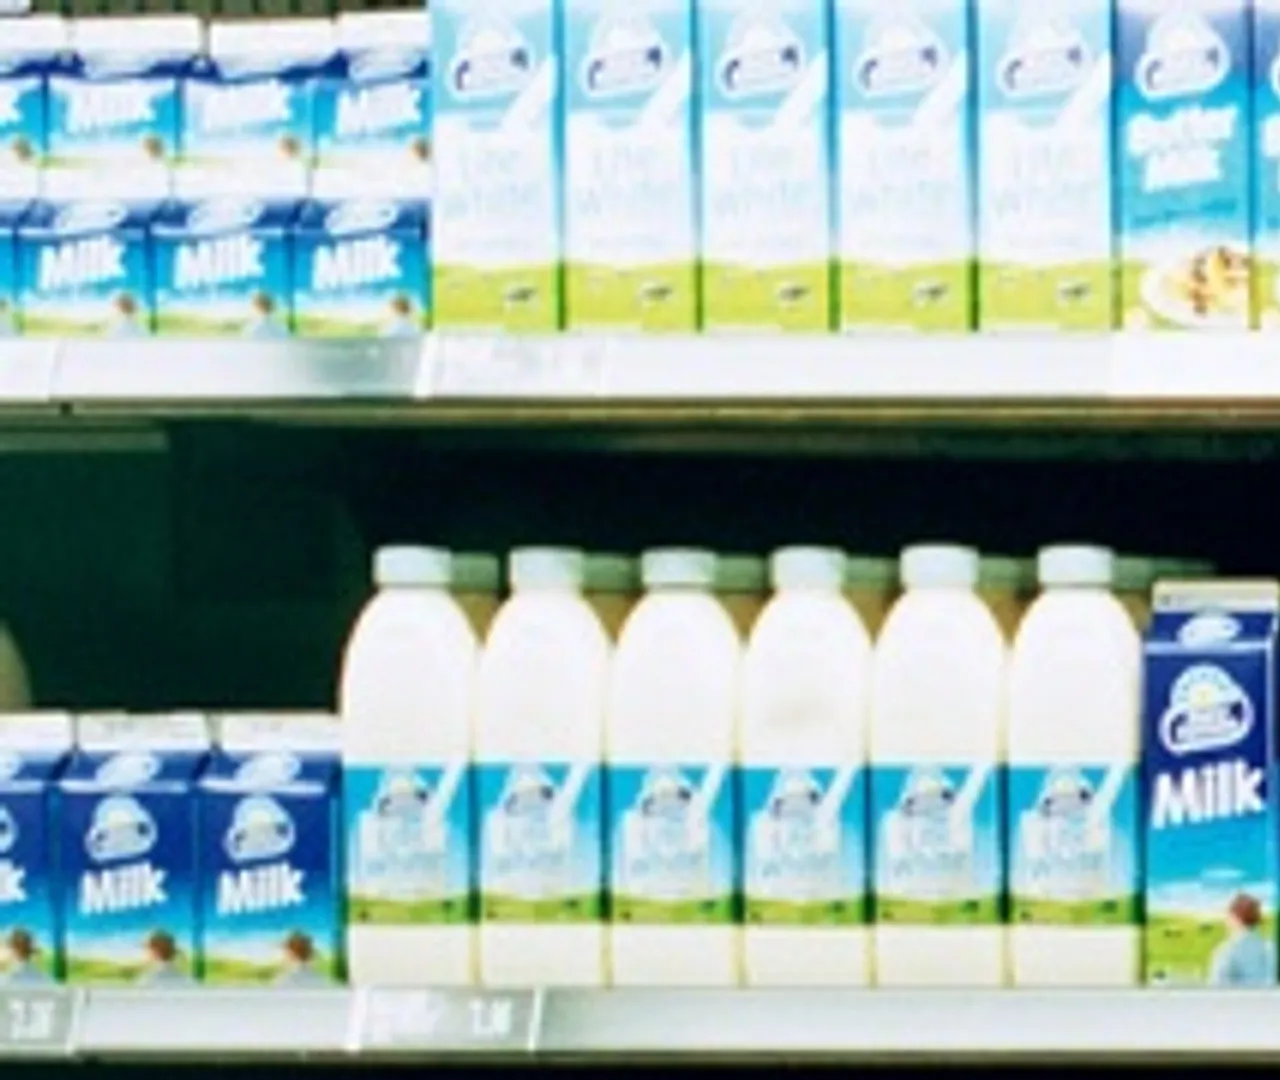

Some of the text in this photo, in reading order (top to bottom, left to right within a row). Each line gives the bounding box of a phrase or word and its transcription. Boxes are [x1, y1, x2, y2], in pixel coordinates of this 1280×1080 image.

[1126, 106, 1237, 156] Butter
[1143, 146, 1220, 192] Milk
[39, 235, 123, 291] Milk
[175, 235, 262, 291] Milk
[313, 235, 399, 291] Milk
[1151, 759, 1264, 829] Milk
[80, 862, 166, 914] Milk
[217, 862, 303, 914] Milk
